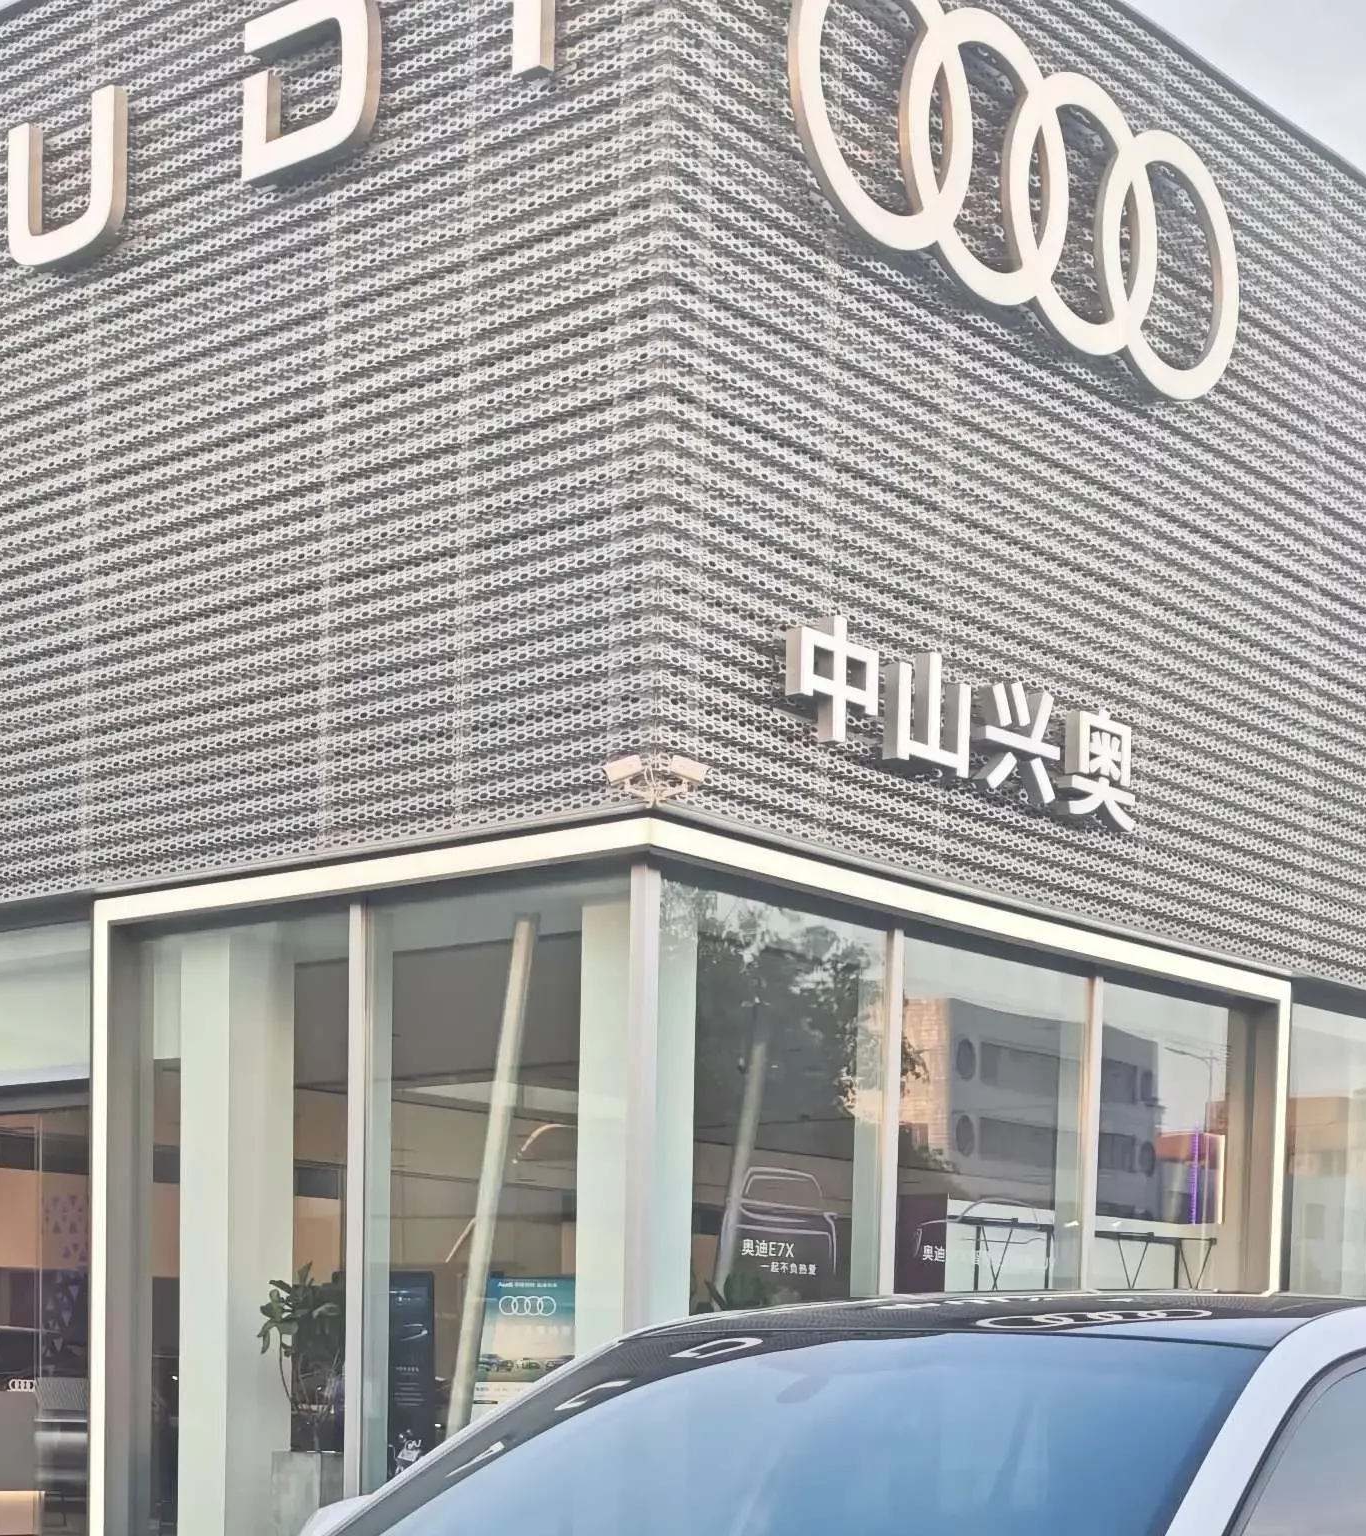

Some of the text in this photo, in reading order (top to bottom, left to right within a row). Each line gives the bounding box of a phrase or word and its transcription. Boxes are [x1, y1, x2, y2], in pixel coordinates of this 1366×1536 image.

[785, 615, 1137, 833] 中山兴奥
[741, 1239, 795, 1258] 奥迪E7X
[760, 1261, 818, 1276] 一起不负热爱
